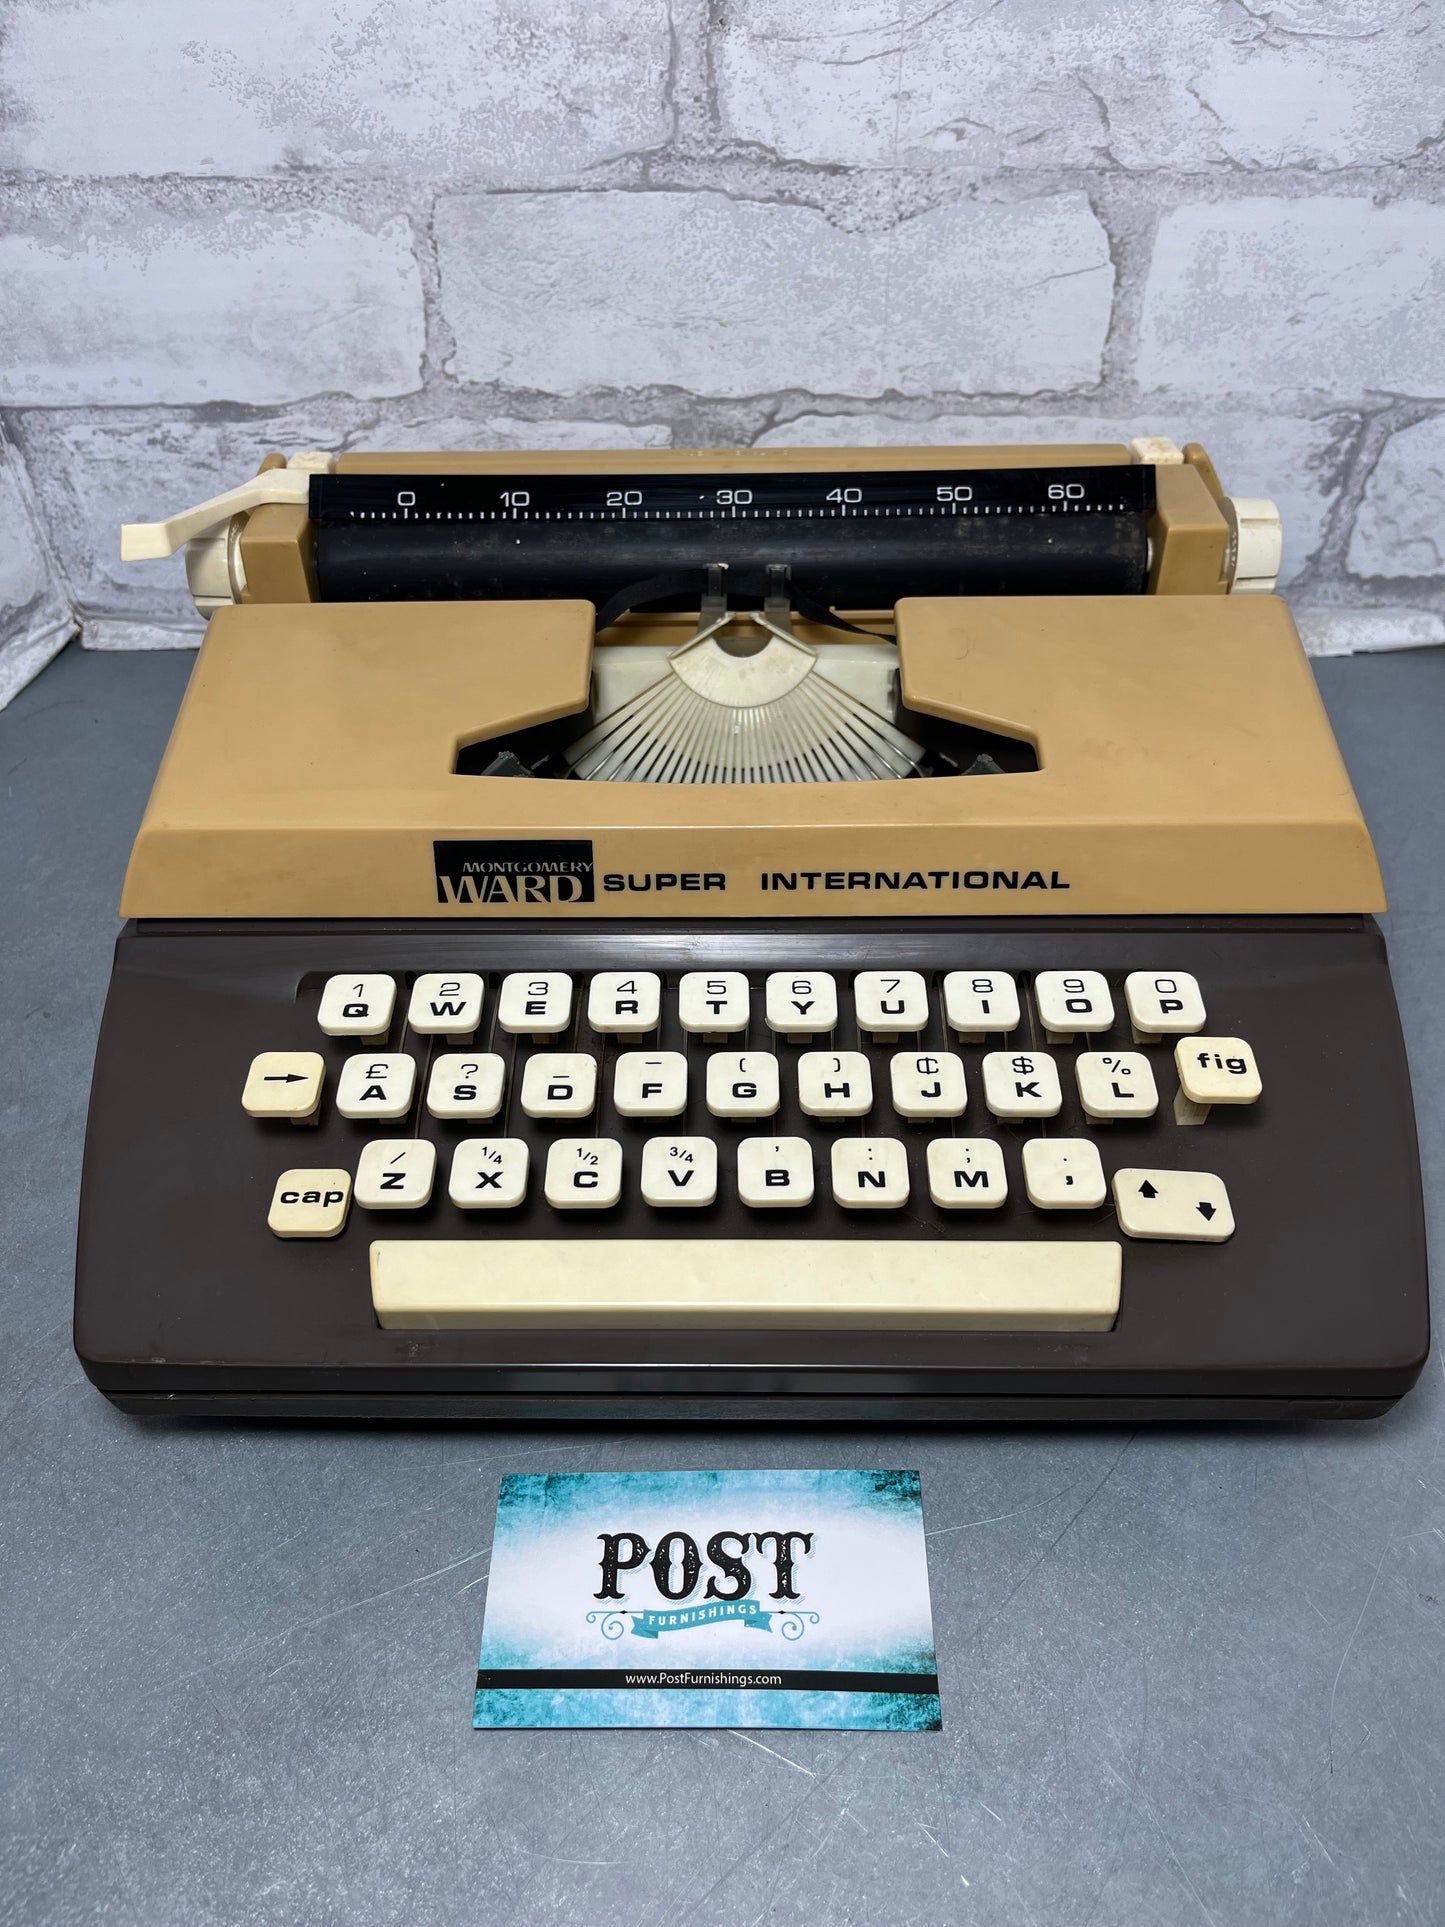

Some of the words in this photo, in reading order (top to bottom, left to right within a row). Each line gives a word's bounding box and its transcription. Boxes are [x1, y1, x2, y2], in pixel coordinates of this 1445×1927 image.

[398, 492, 415, 505] 0
[500, 492, 529, 506] 10
[607, 491, 642, 506] 20
[716, 490, 752, 505] 30
[826, 489, 862, 503] 40
[936, 487, 972, 502] 50
[1047, 484, 1084, 499] 60
[463, 861, 592, 873] MONTGOMERY
[604, 873, 725, 891] SUPER
[762, 871, 1070, 890] INTERNATIONAL
[440, 876, 582, 902] WARD
[352, 983, 364, 998] 1
[439, 983, 460, 996] 2
[528, 982, 548, 995] 3
[617, 981, 637, 994] 4
[707, 981, 726, 994] 5
[792, 981, 811, 994] 6
[880, 980, 900, 993] 7
[972, 979, 993, 993] 8
[1064, 979, 1084, 993] 9
[1155, 979, 1177, 993] 0
[343, 1004, 368, 1017] Q
[430, 1002, 466, 1016] W
[525, 1001, 546, 1015] E
[616, 1000, 638, 1014] R
[706, 1001, 727, 1014] T
[791, 1001, 815, 1015] Y
[881, 1000, 905, 1014] U
[981, 999, 991, 1014] I
[1066, 999, 1092, 1013] O
[1159, 1000, 1183, 1013] P
[366, 1064, 388, 1079] £
[461, 1064, 478, 1078] ?
[1012, 1056, 1034, 1075] $
[1103, 1058, 1131, 1074] %
[1197, 1053, 1247, 1075] fig
[360, 1085, 386, 1100] A
[453, 1085, 476, 1100] S
[547, 1085, 573, 1100] D
[642, 1083, 662, 1098] F
[733, 1083, 756, 1098] G
[824, 1083, 850, 1098] H
[921, 1082, 941, 1097] J
[1015, 1082, 1042, 1097] K
[1112, 1083, 1134, 1097] L
[380, 1173, 405, 1189] Z
[475, 1172, 503, 1188] X
[574, 1172, 598, 1188] C
[668, 1170, 694, 1186] V
[766, 1170, 790, 1186] B
[858, 1171, 885, 1187] N
[954, 1171, 988, 1187] M
[280, 1190, 344, 1207] cap
[592, 1531, 814, 1600] POST
[648, 1604, 757, 1625] FURNISHINGS
[626, 1672, 781, 1687] www.PostFurnishings.com
